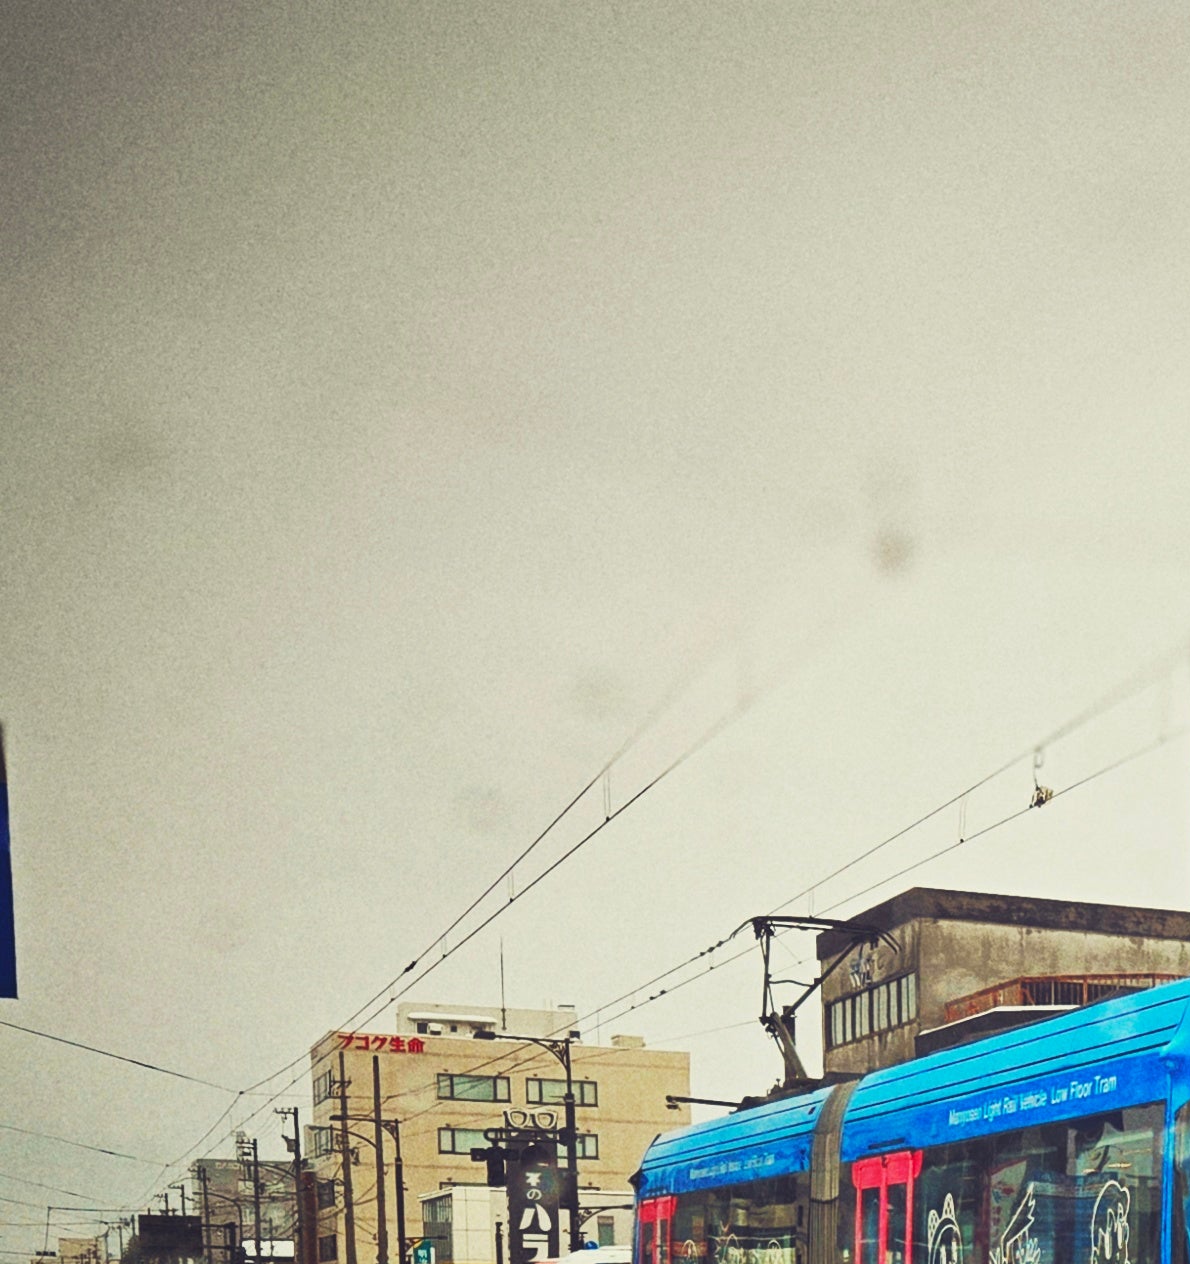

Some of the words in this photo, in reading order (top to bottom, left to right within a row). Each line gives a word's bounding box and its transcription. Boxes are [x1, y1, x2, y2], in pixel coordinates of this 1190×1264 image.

[337, 1034, 425, 1053] フコク生命
[983, 1103, 1002, 1122] Light
[1050, 1086, 1068, 1105] Low
[1070, 1080, 1093, 1099] Floor
[1094, 1075, 1117, 1094] Tram
